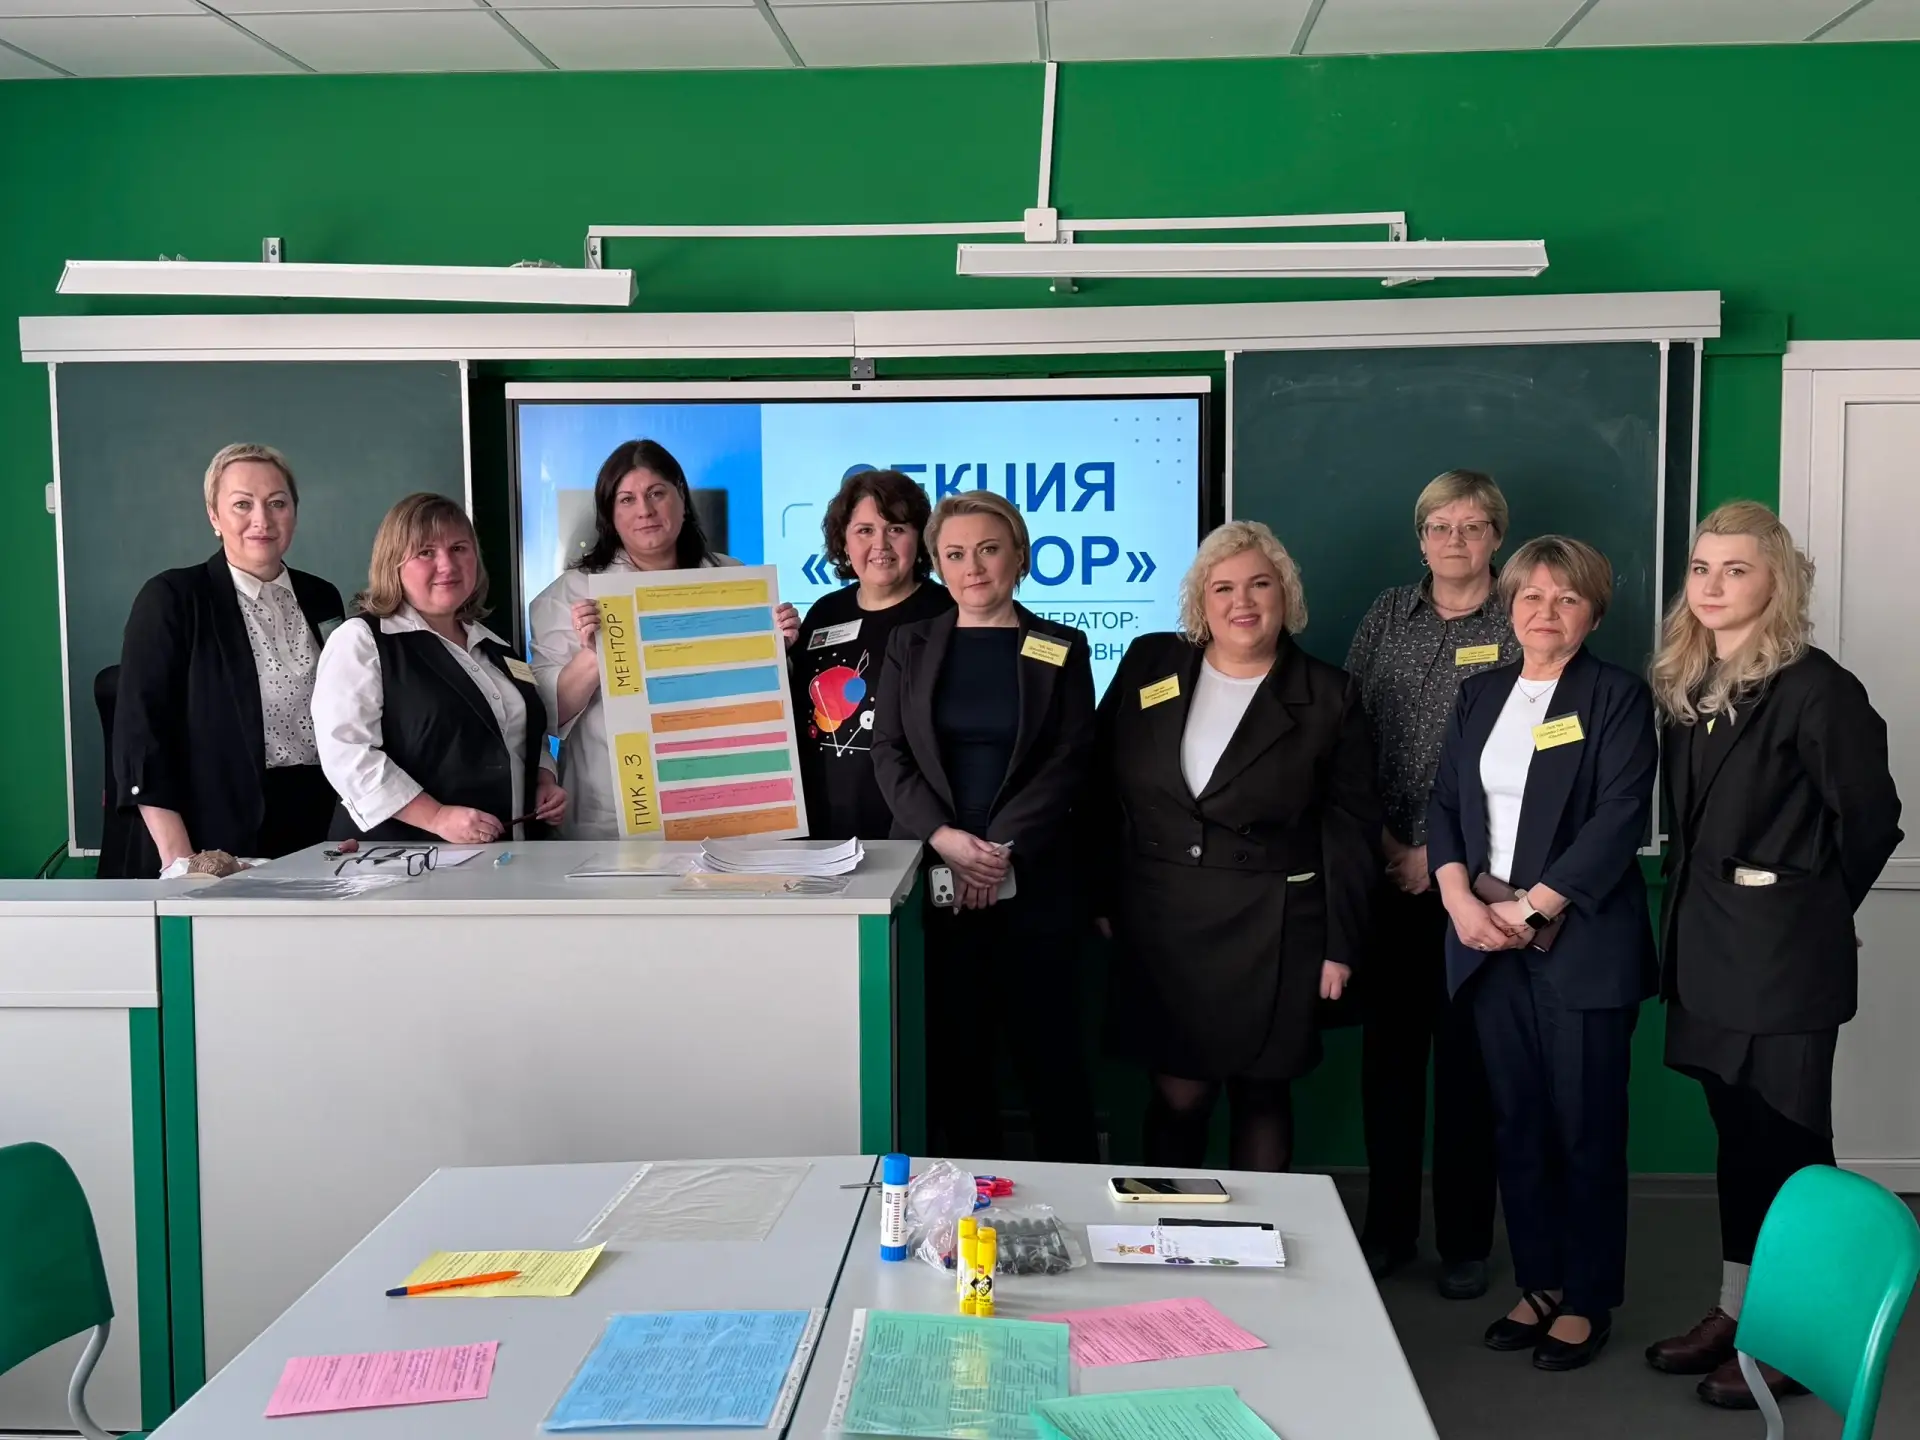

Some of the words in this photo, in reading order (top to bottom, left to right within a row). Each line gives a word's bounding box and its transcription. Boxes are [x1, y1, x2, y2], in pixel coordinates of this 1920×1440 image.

[841, 462, 1115, 512] КЦИЯ
[1034, 611, 1139, 629] ЕРАТОР:
[624, 754, 642, 767] 3
[630, 786, 652, 826] ПИК
